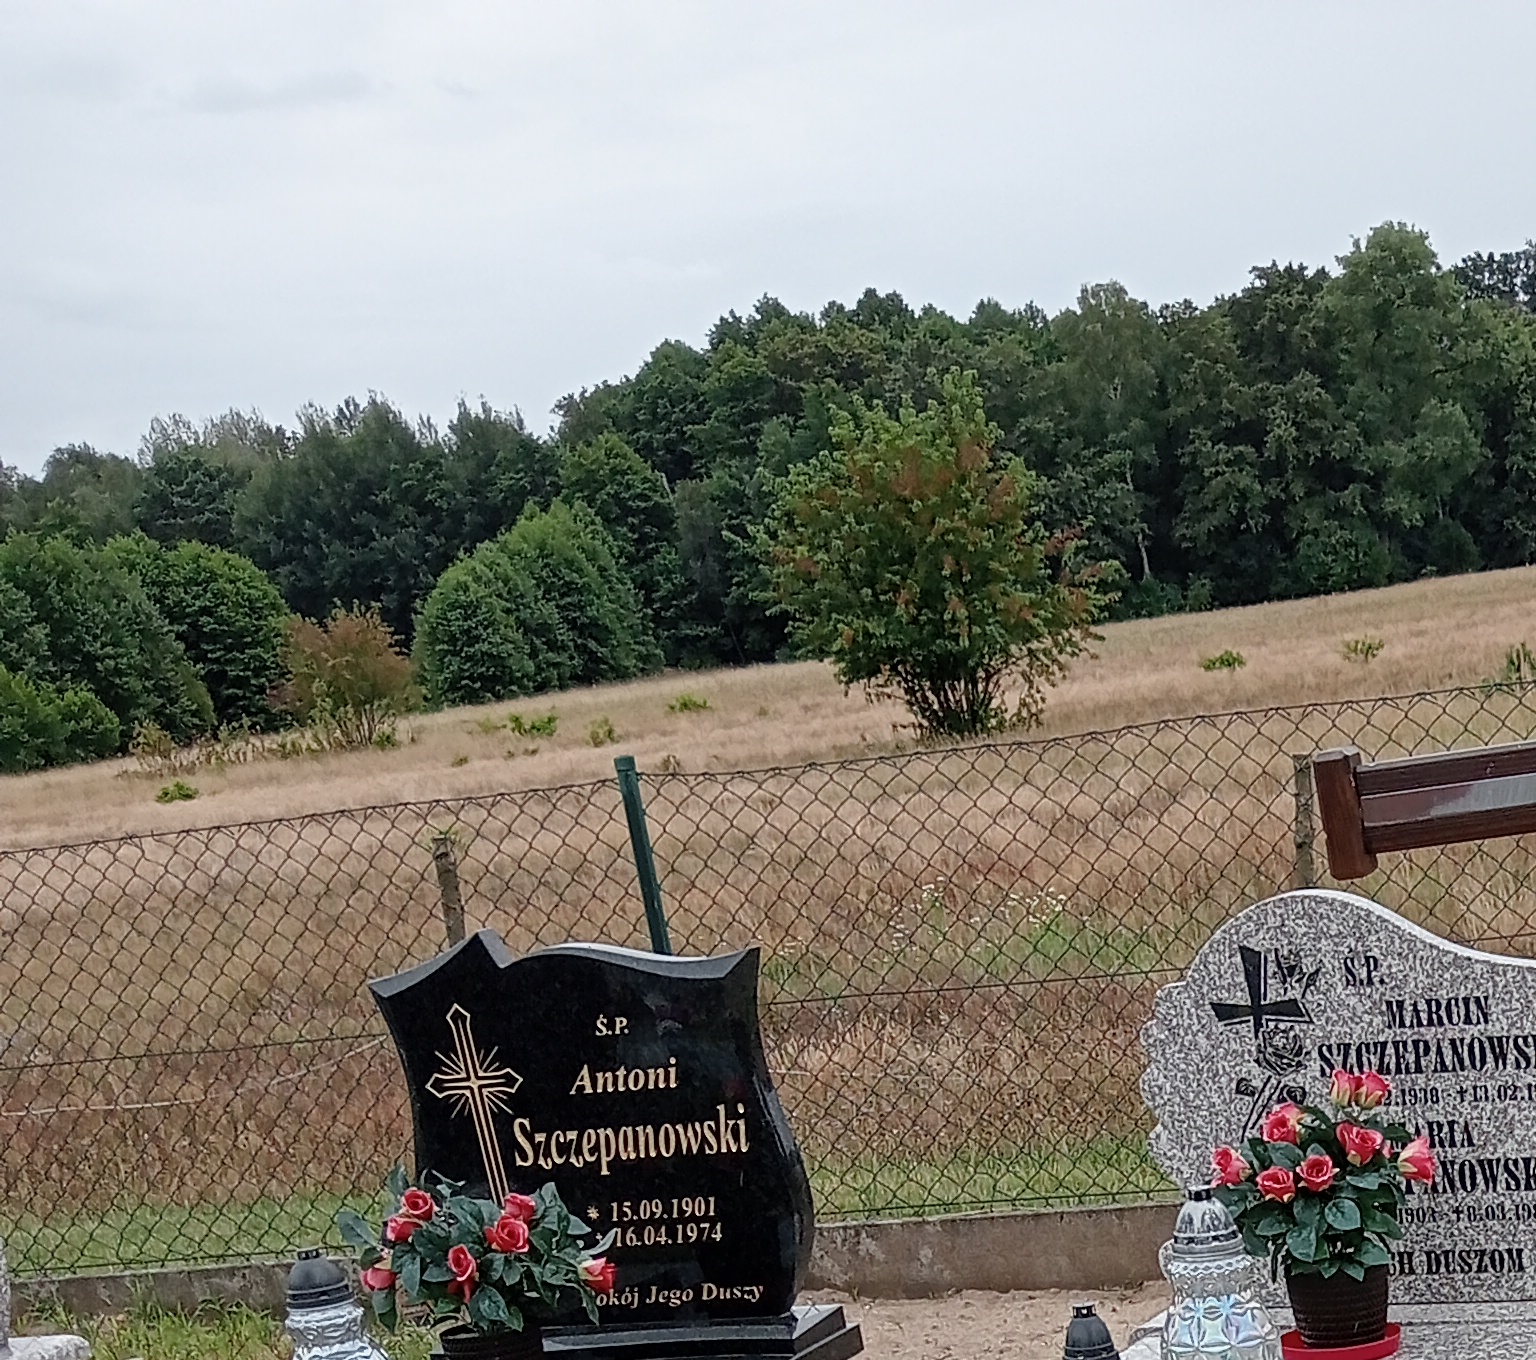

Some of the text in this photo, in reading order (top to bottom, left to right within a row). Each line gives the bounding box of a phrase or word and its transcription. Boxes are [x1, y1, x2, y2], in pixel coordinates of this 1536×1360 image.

[594, 1014, 630, 1036] Ś.P.
[1385, 995, 1490, 1029] MARCIN
[569, 1056, 679, 1095] Antoni
[513, 1103, 750, 1176] Szczepanowski
[610, 1196, 717, 1222] 15.09.1901
[614, 1222, 723, 1248] 16.04.1974
[1425, 1248, 1526, 1275] DUSZOM
[592, 1282, 764, 1309] okój Jego Duszy
